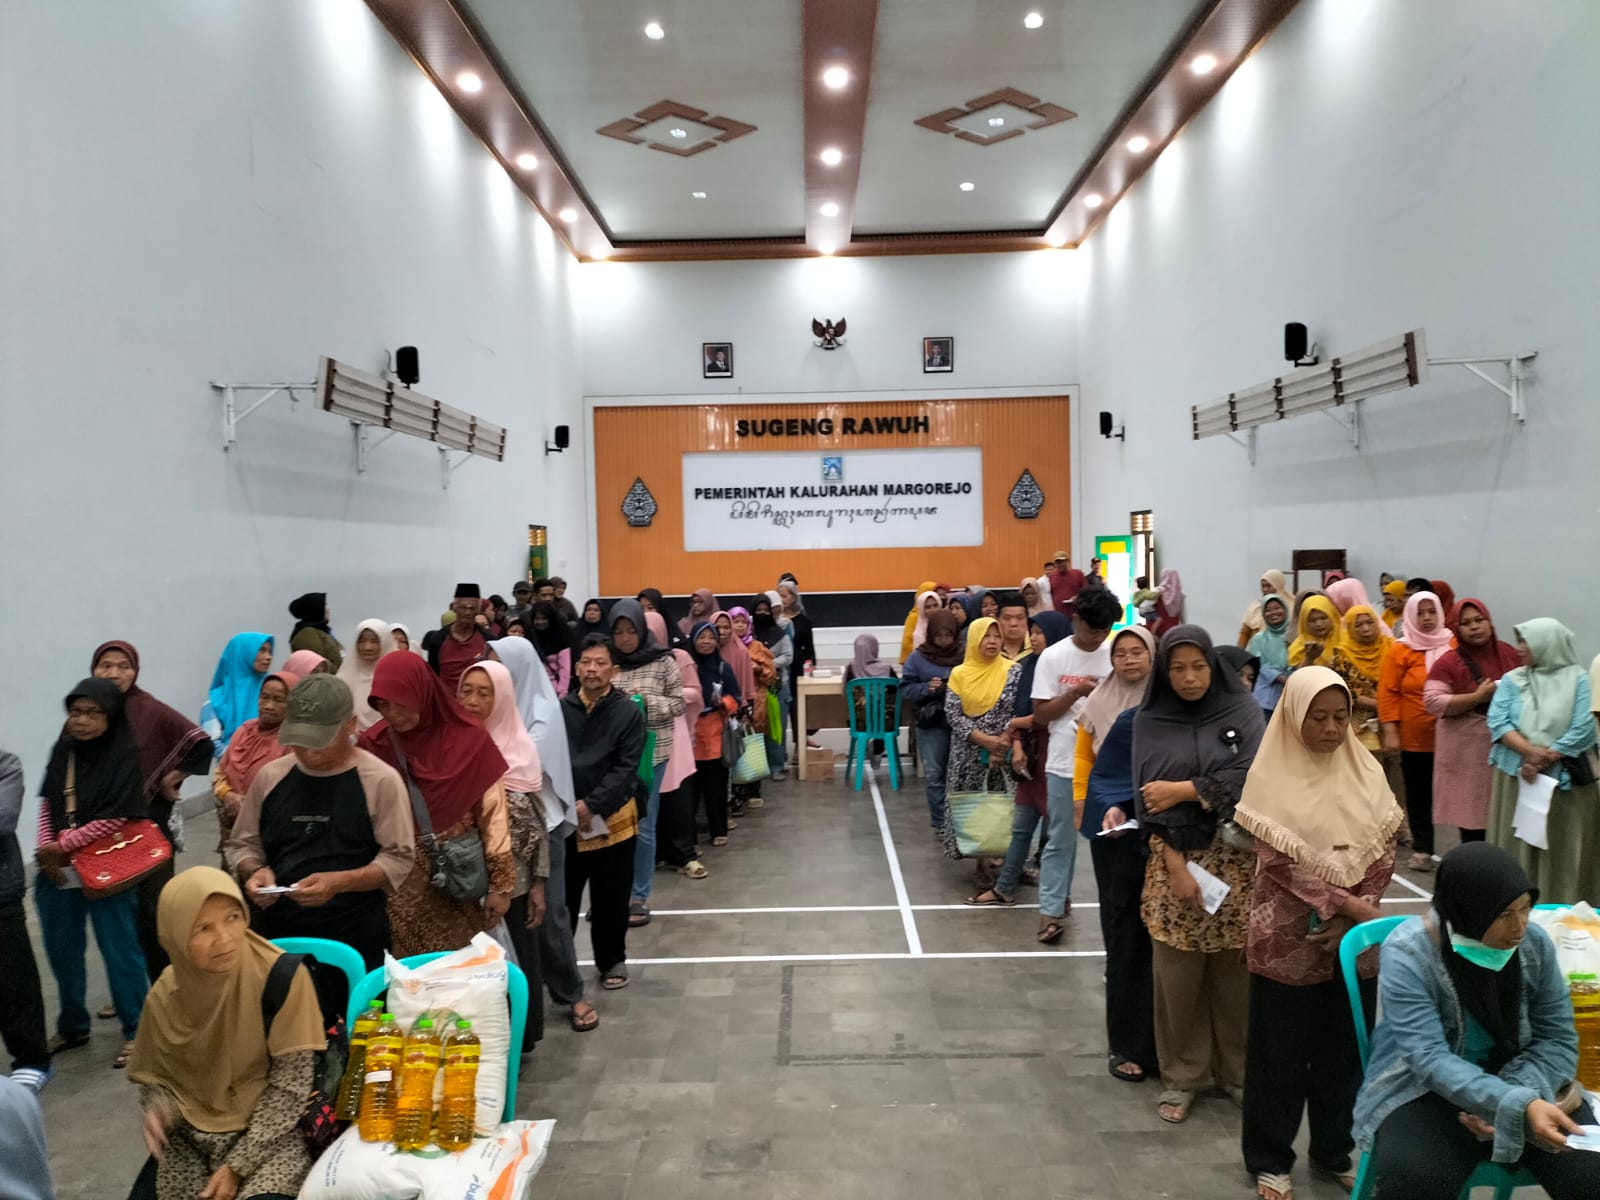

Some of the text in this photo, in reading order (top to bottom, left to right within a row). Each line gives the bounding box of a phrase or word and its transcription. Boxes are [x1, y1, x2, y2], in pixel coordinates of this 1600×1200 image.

[736, 415, 929, 438] SUGENG RAWUH
[694, 482, 972, 500] PEMERINTAH KALURAHAN MARGOREJO
